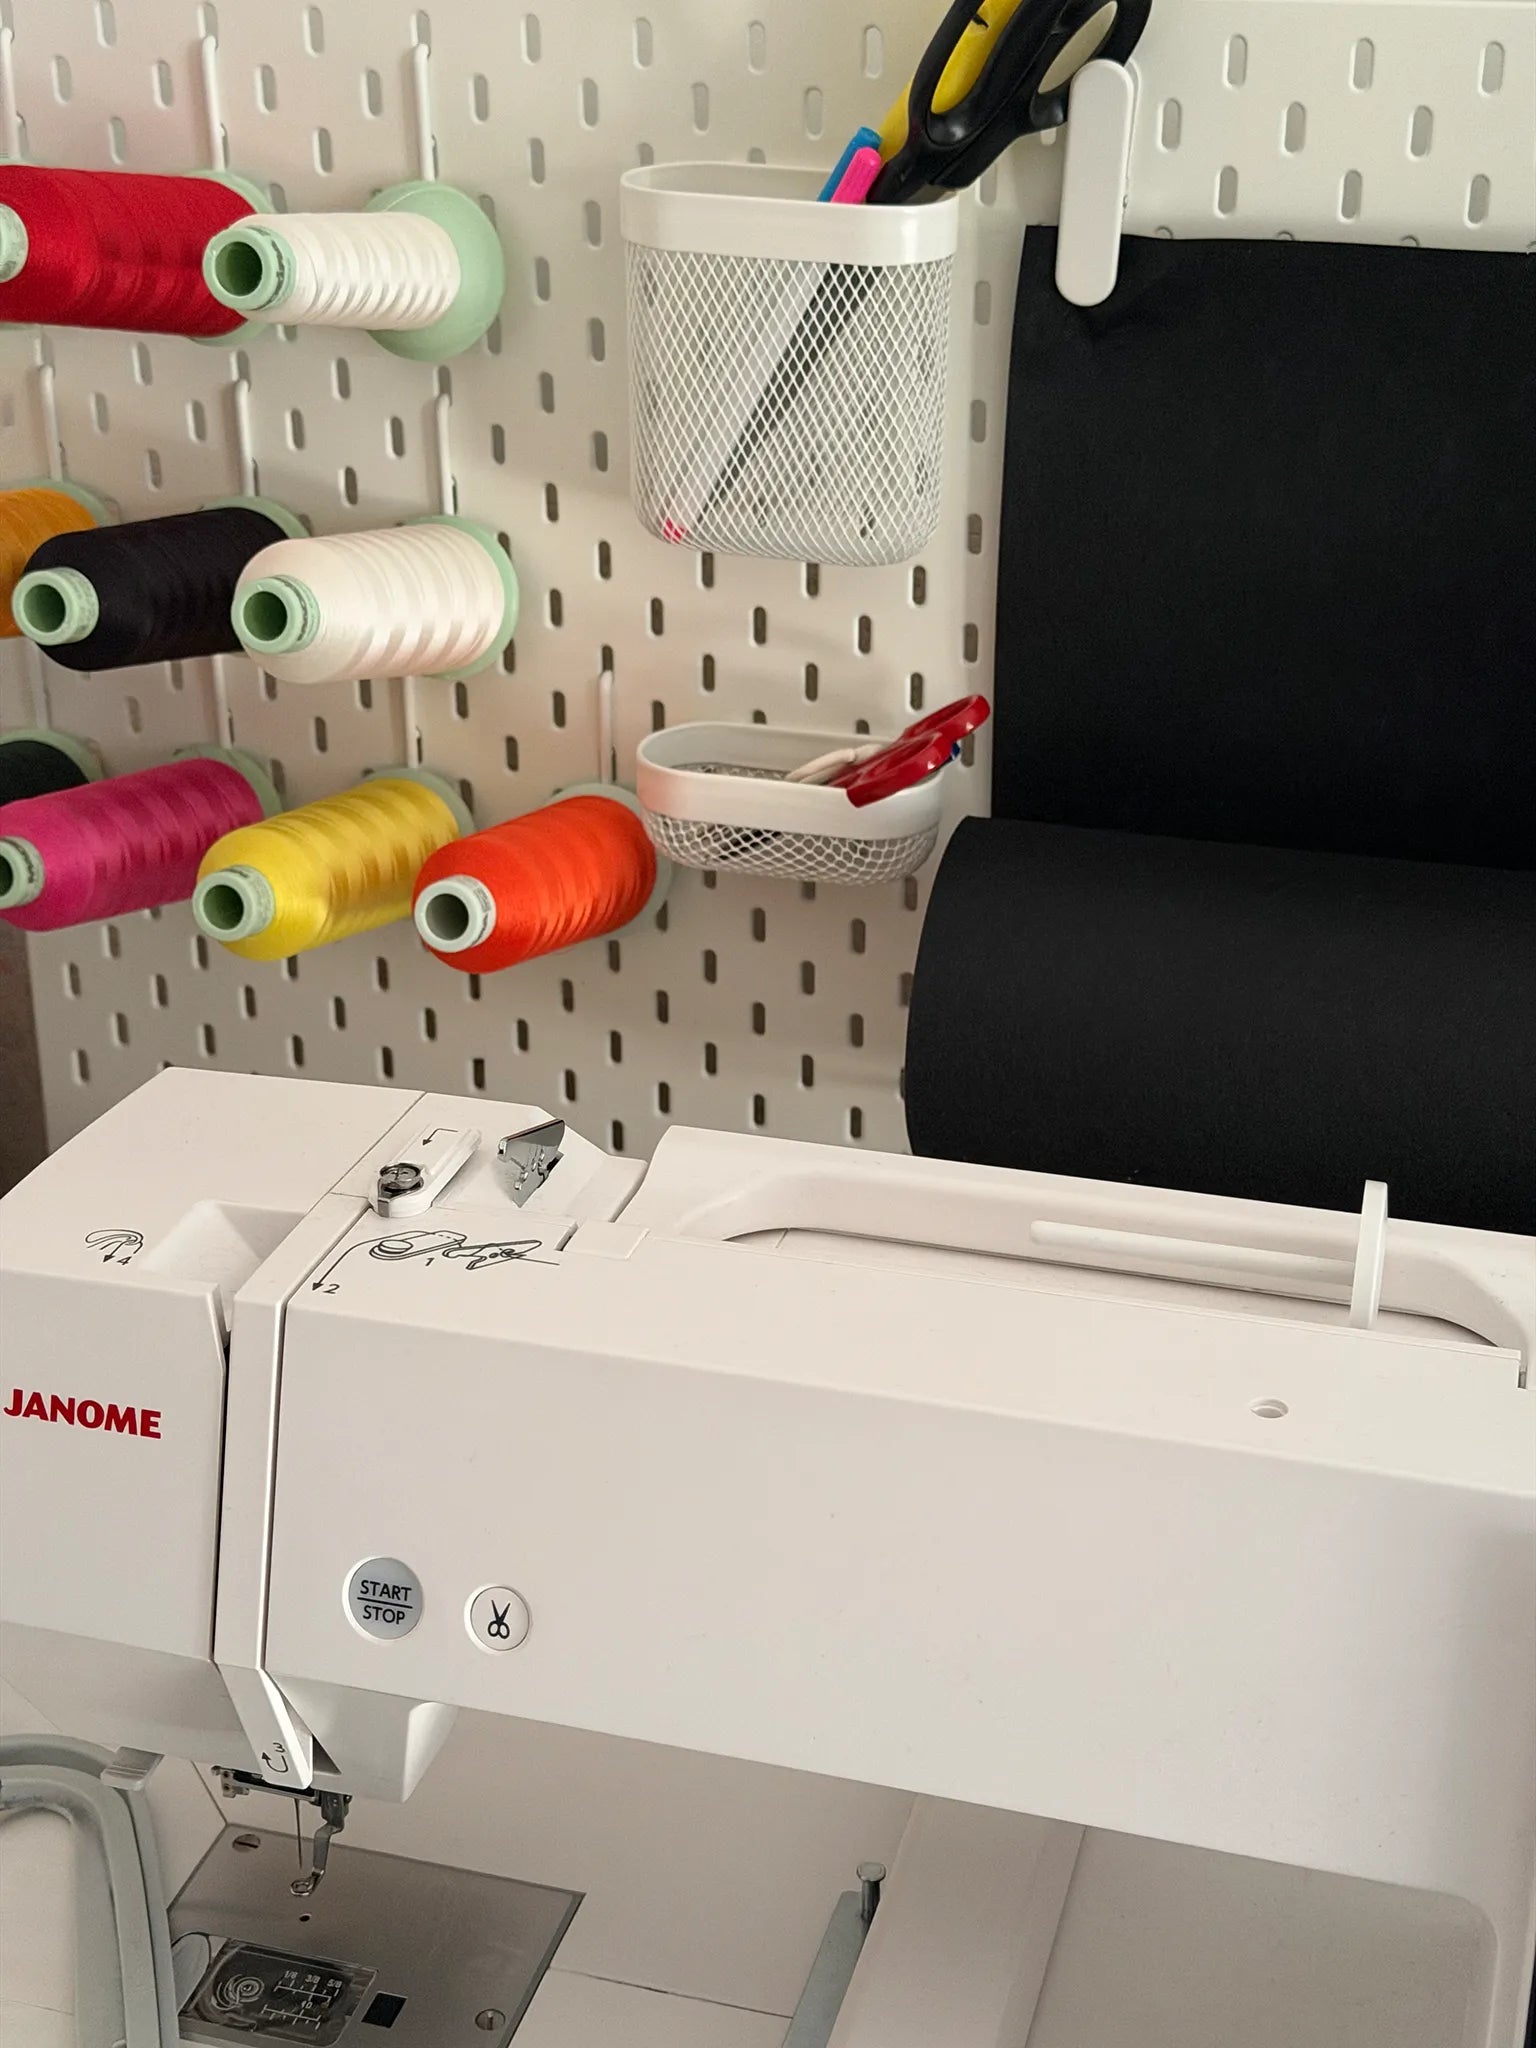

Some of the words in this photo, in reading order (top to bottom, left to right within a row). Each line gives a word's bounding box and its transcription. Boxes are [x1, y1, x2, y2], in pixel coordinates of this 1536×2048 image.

[116, 1256, 132, 1265] 4
[425, 1257, 435, 1266] 1
[322, 1283, 340, 1294] 2
[3, 1389, 161, 1439] JANOME
[360, 1580, 412, 1601] START
[363, 1605, 405, 1625] STOP
[272, 1742, 286, 1753] 3
